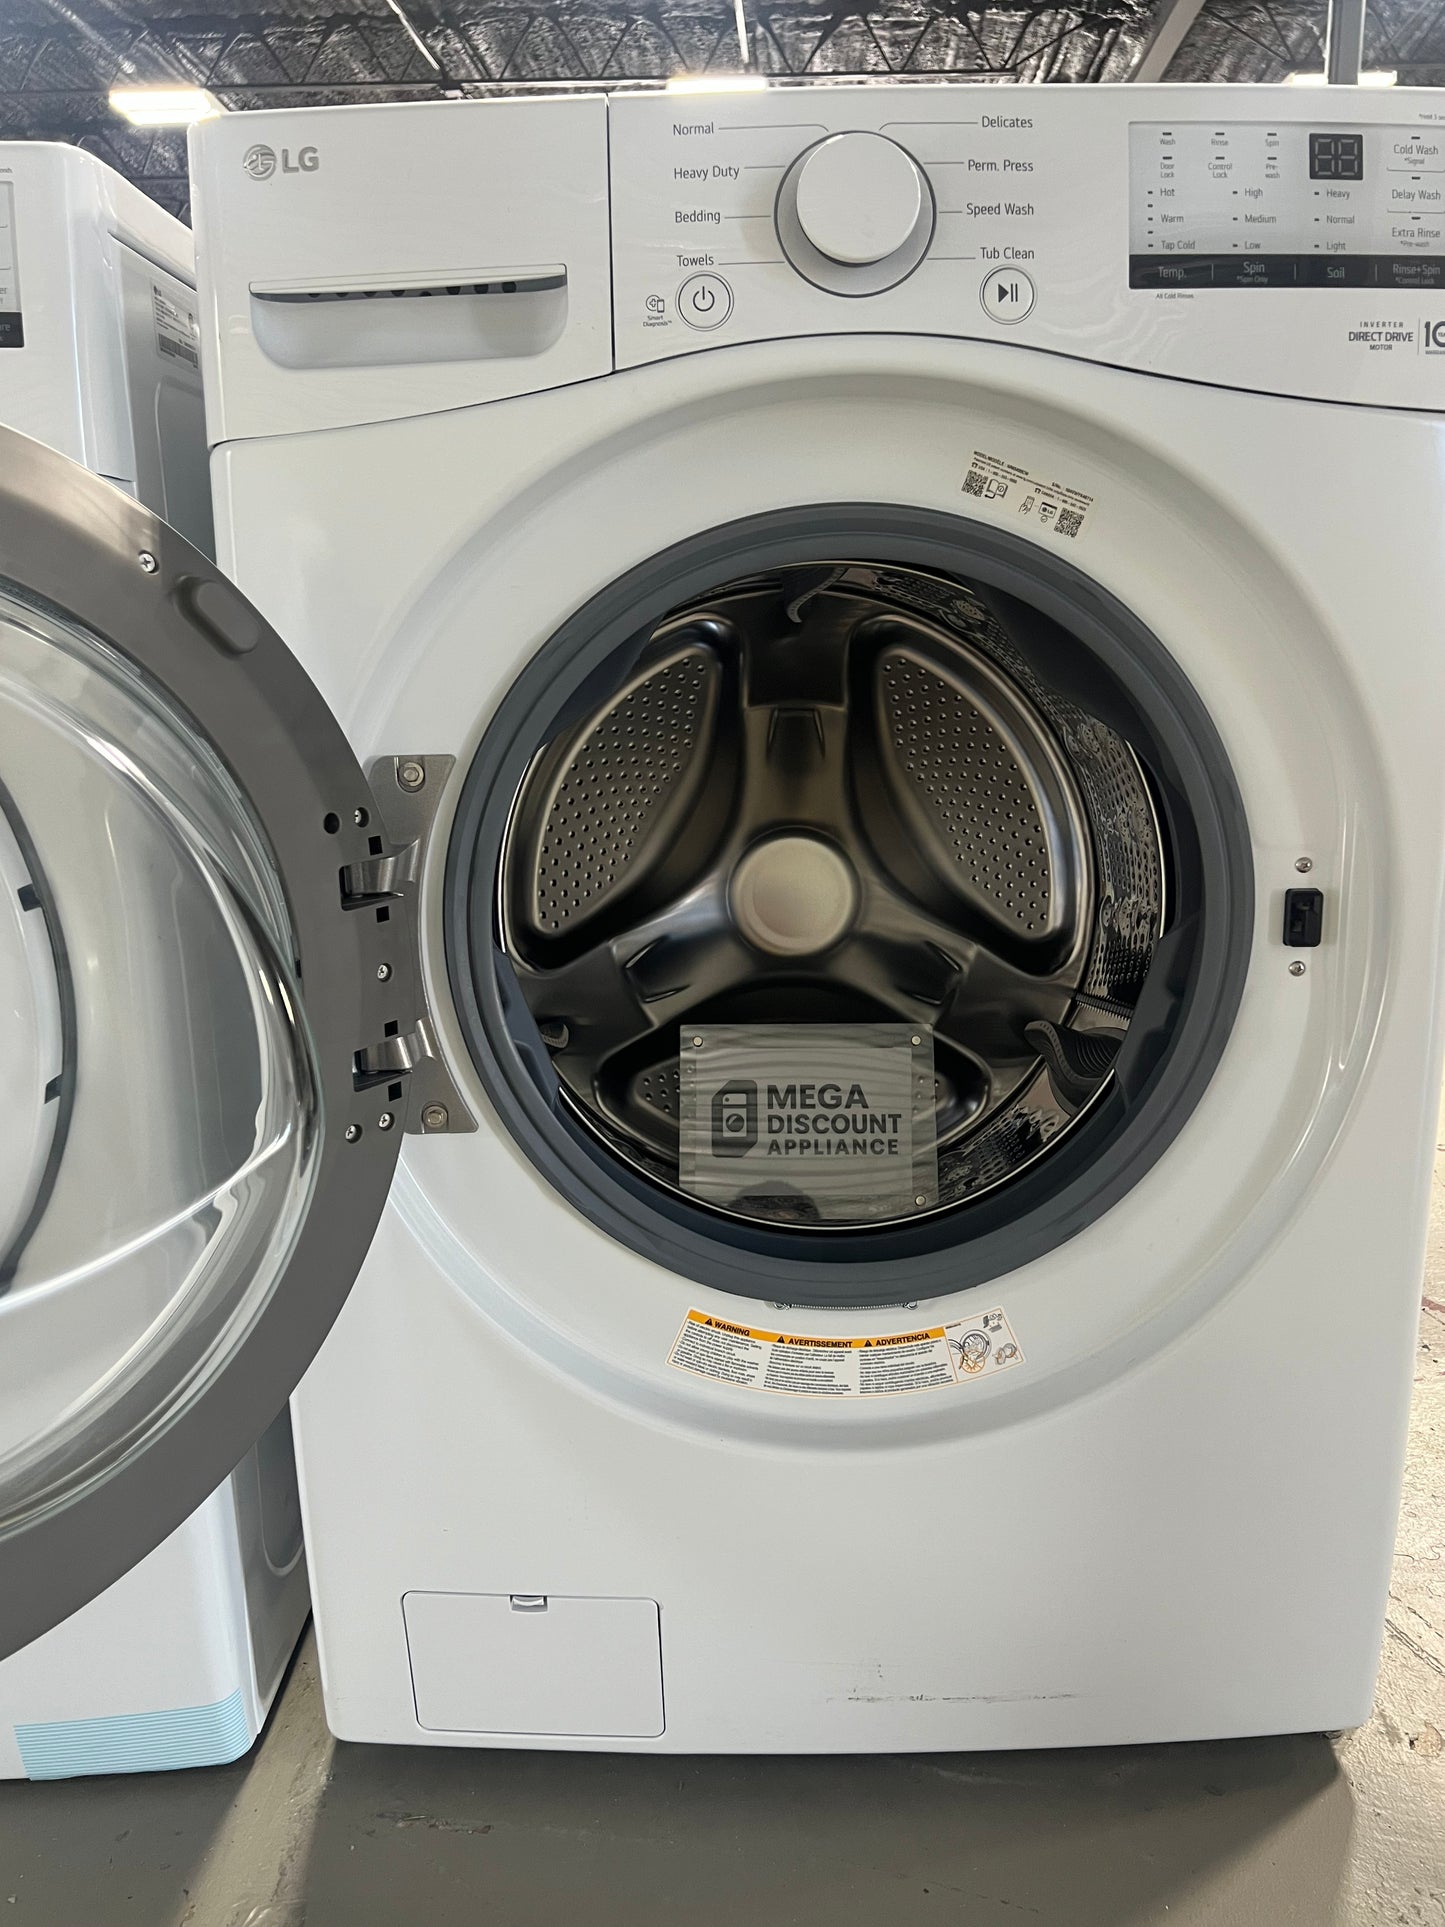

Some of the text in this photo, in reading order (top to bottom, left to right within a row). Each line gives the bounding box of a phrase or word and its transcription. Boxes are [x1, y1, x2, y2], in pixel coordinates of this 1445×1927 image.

[981, 115, 1033, 128] Delicates
[673, 121, 714, 136] Normal
[1160, 138, 1176, 146] Wash
[1211, 138, 1229, 147] Rinse
[1265, 138, 1279, 147] Spin
[1393, 143, 1439, 155] Cold Wash
[282, 146, 319, 174] LG
[968, 159, 1034, 172] Perm. Press
[1160, 162, 1175, 171] Door
[1208, 162, 1232, 171] Control
[674, 165, 740, 182] Heavy Duty
[1160, 170, 1175, 179] Lock
[1212, 170, 1228, 179] Lock
[1160, 187, 1175, 197] Hot
[1244, 187, 1264, 199] High
[1326, 188, 1351, 200] Heavy
[1391, 188, 1442, 202] Delay Wash
[966, 202, 1034, 218] Speed Wash
[675, 210, 721, 225] Bedding
[1160, 213, 1185, 223] Warm
[1244, 213, 1277, 224] Medium
[1326, 215, 1355, 225] Normal
[1391, 226, 1441, 238] Extra Rinse
[1161, 240, 1196, 252] Tap Cold
[1244, 240, 1261, 250] Low
[1326, 241, 1346, 252] Light
[980, 246, 1035, 260] Tub Clean
[676, 253, 715, 267] Towels
[1159, 266, 1187, 280] Temp.
[1243, 261, 1266, 275] Spin
[1327, 266, 1345, 279] Soil
[1360, 320, 1404, 328] INVERTER
[1348, 331, 1414, 342] DIRECT DRIVE
[766, 1083, 869, 1110] MEGA
[766, 1113, 902, 1135] DISCOUNT
[766, 1138, 899, 1156] APPLIANCE
[714, 1320, 751, 1337] WARNING
[788, 1337, 853, 1349] AVERTISSEMENT
[875, 1332, 931, 1347] ADVERTENCIA
